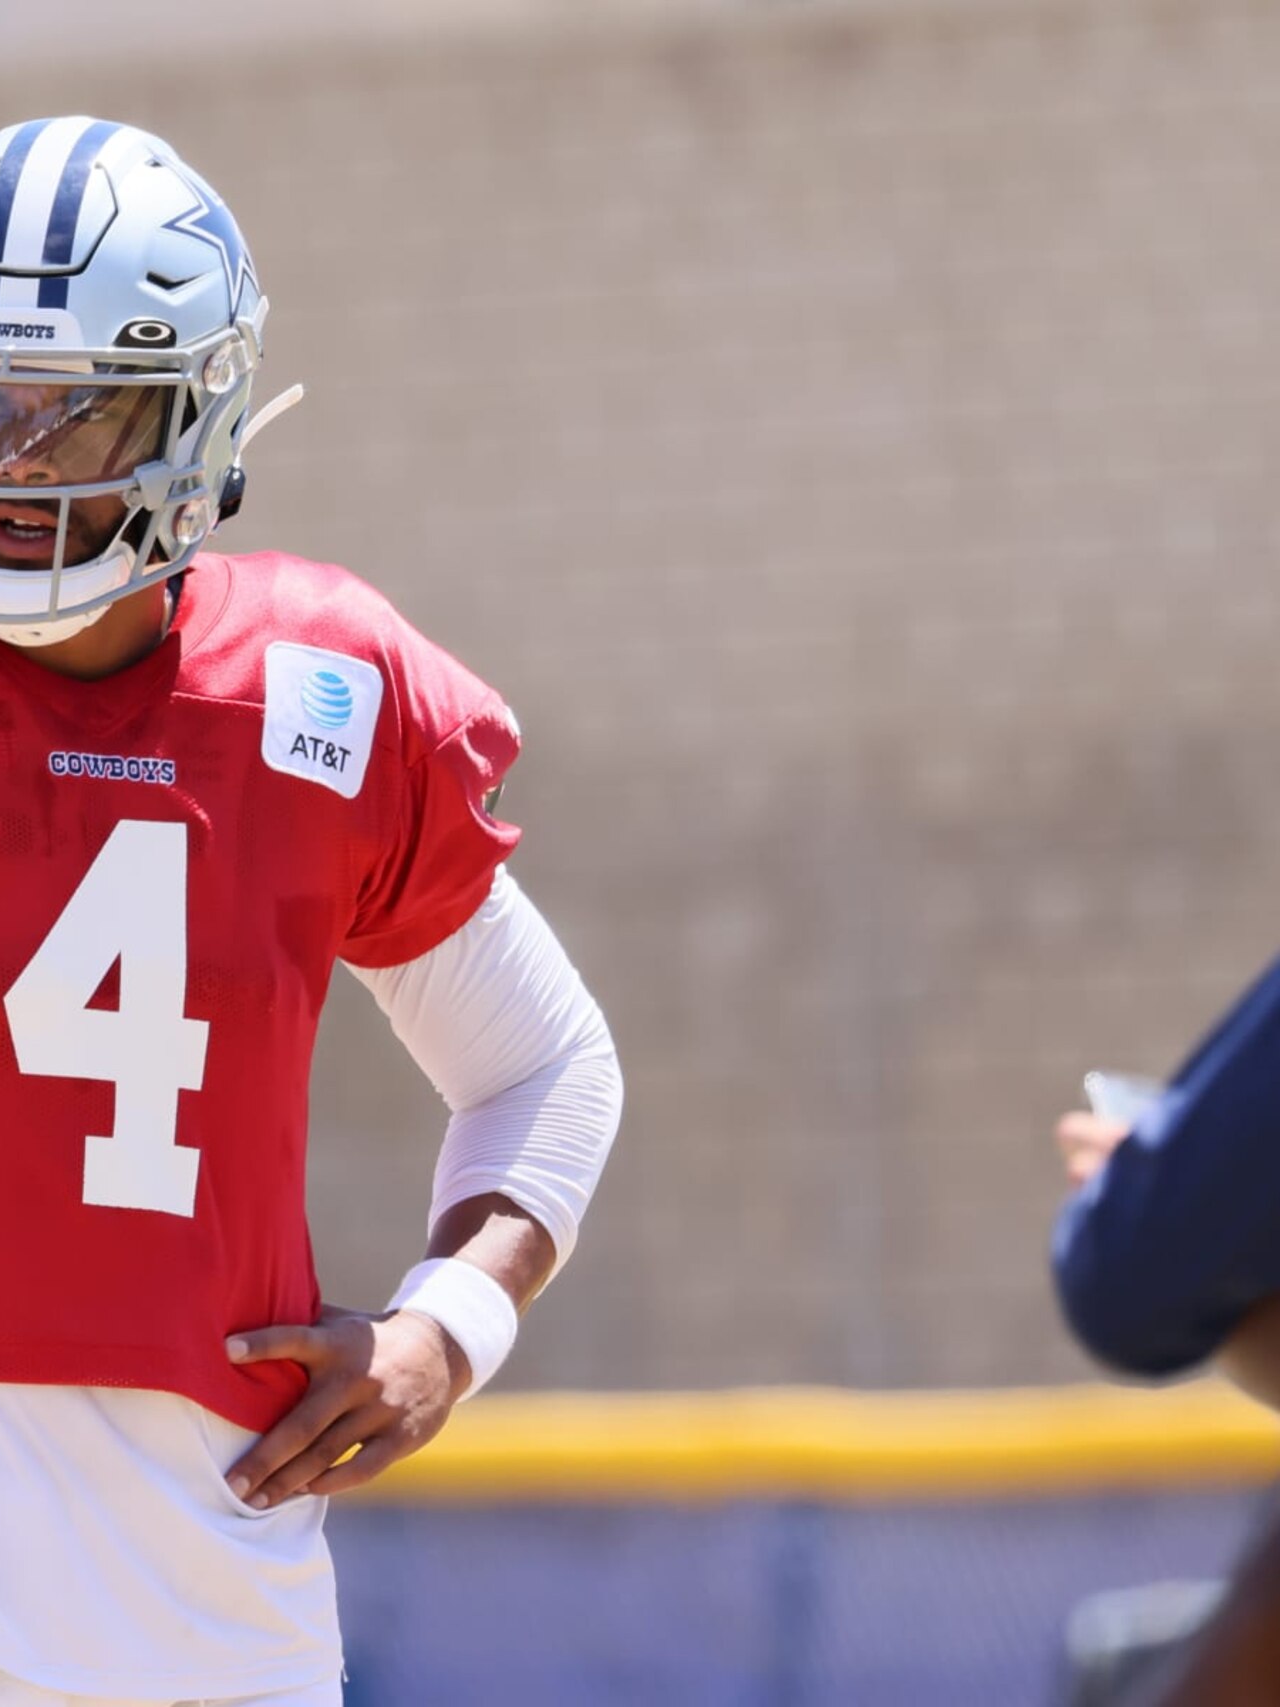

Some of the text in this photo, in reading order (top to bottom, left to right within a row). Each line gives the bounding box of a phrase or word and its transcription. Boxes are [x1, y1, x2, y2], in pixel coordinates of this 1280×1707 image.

[49, 751, 176, 784] COWBOYS
[289, 732, 352, 773] AT&T
[3, 819, 210, 1218] 4
